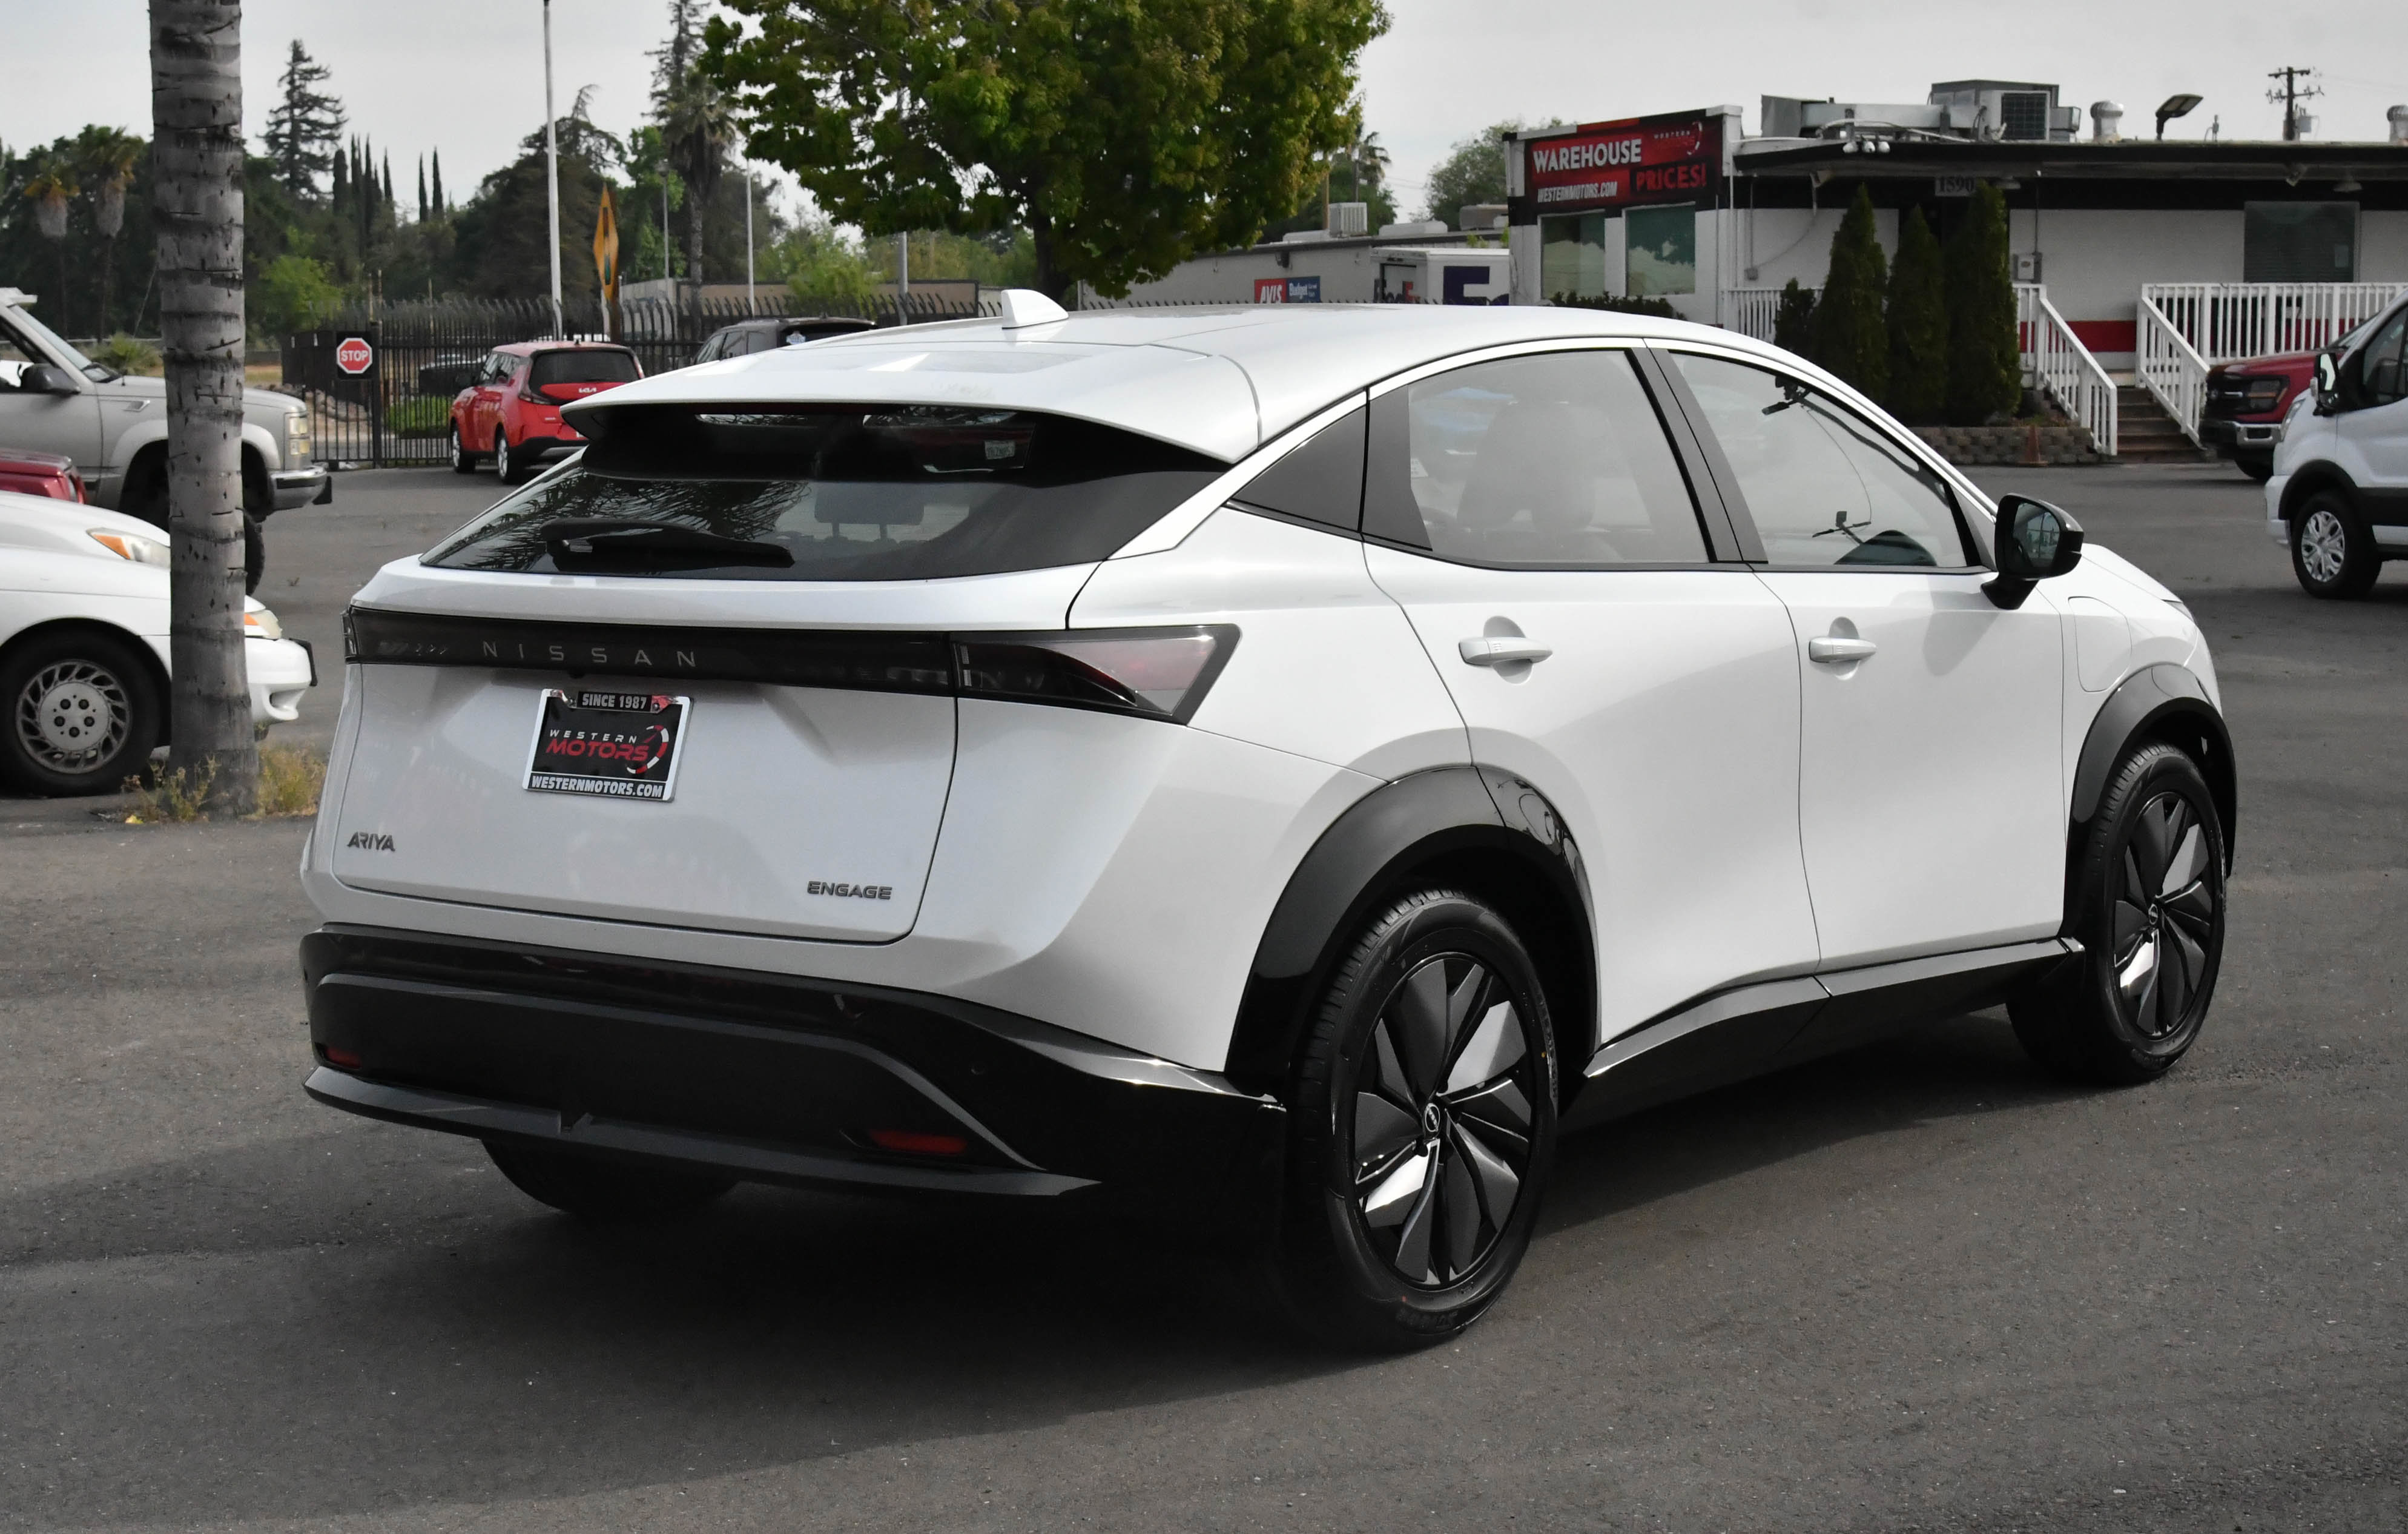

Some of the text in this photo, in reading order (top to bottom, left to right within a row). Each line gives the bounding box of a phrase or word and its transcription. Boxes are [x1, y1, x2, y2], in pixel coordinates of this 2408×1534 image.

[1532, 138, 1642, 174] WAREHOUSE
[1636, 162, 1707, 192] PRICES!
[1537, 180, 1618, 203] WESTERNMOTORS.COM
[1260, 284, 1282, 303] AVIS
[1288, 283, 1308, 300] Budget
[341, 349, 369, 362] STOP
[483, 640, 696, 667] NISSAN
[582, 693, 648, 710] SINCE 1987
[549, 729, 638, 744] WESTERN
[546, 738, 650, 761] MOTORS
[532, 775, 664, 798] WESTERNMOTORS.COM
[346, 831, 396, 852] ARIYA
[807, 880, 893, 901] ENGAGE
